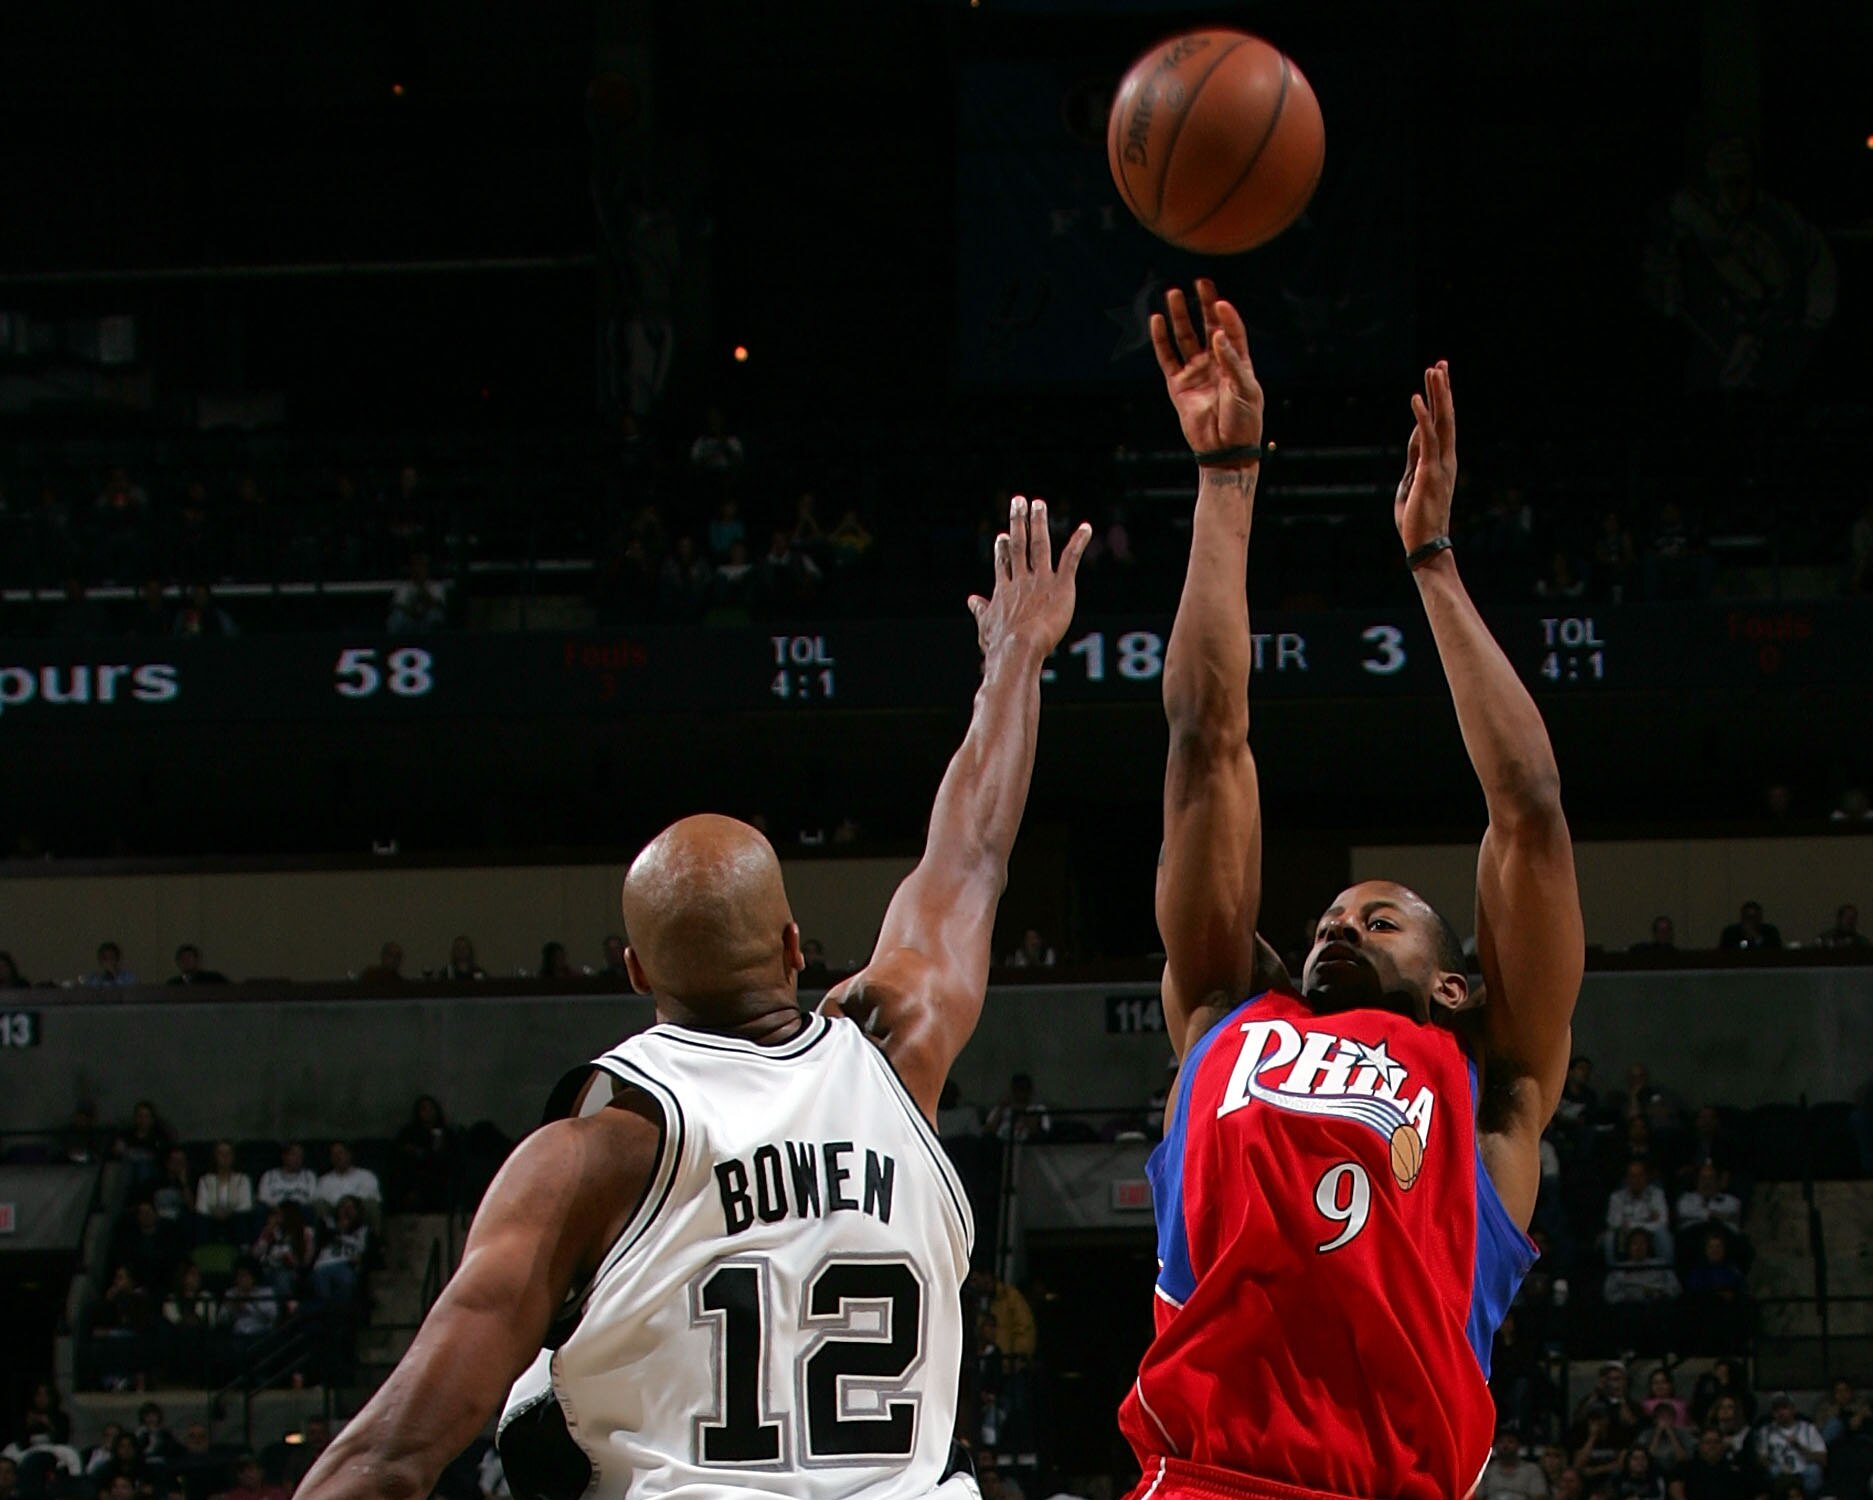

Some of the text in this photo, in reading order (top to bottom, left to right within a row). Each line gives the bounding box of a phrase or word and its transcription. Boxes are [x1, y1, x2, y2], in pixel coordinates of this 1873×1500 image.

[1540, 616, 1605, 647] TOL
[768, 635, 836, 666] TOL
[1250, 624, 1407, 676] TR 3
[1540, 650, 1605, 681] 4:1
[333, 647, 434, 698] 58
[769, 668, 836, 699] 4:1
[0, 1013, 31, 1048] 13
[1115, 1000, 1162, 1031] 114
[714, 1140, 895, 1235] BOWEN
[1314, 1160, 1371, 1254] 9
[689, 1251, 928, 1472] 12
